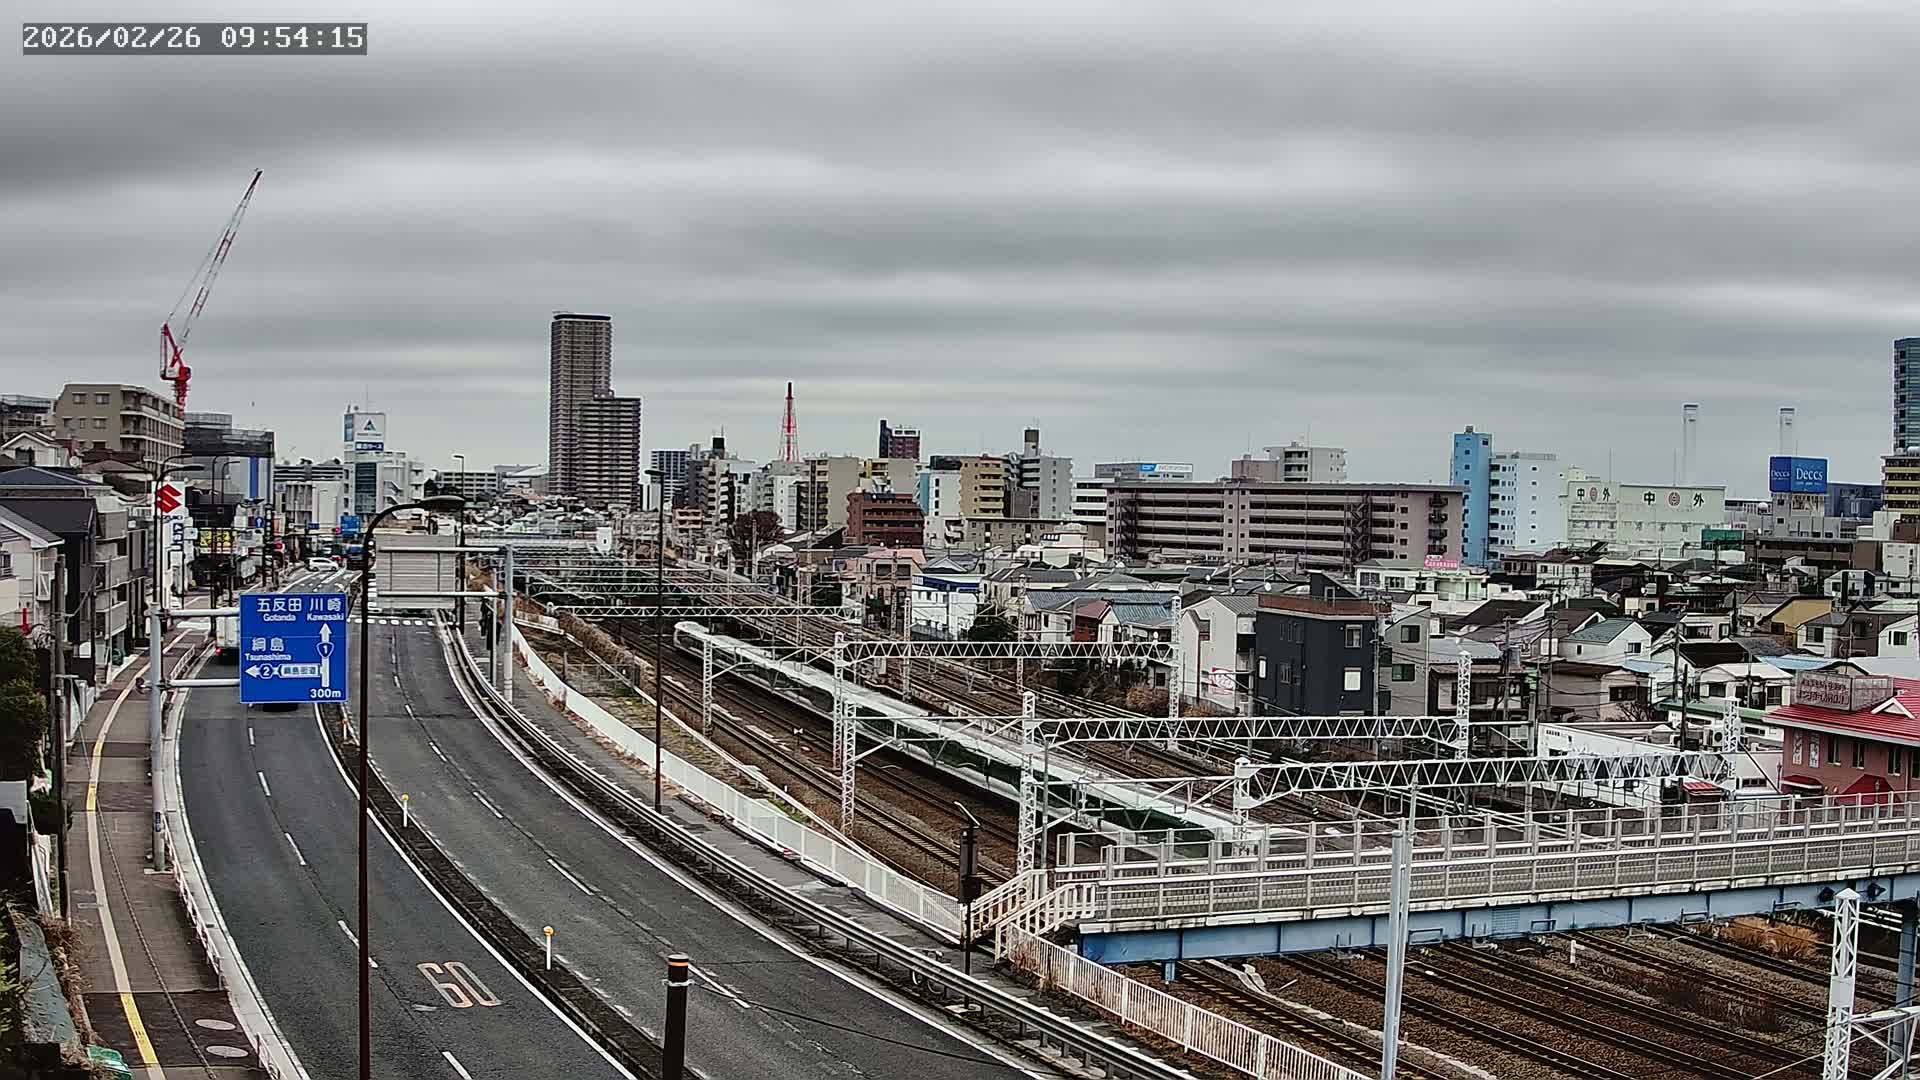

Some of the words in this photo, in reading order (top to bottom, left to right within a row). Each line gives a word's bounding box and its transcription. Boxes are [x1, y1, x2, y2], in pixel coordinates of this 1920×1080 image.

[1796, 467, 1823, 480] Deccs
[257, 598, 302, 612] 五反田
[263, 613, 296, 621] Gotanda
[307, 612, 344, 621] Kawasaki
[322, 645, 328, 654] 1
[245, 653, 292, 661] Tsunashima
[263, 667, 270, 676] 2
[310, 688, 341, 698] 300m
[417, 962, 501, 1008] 60
